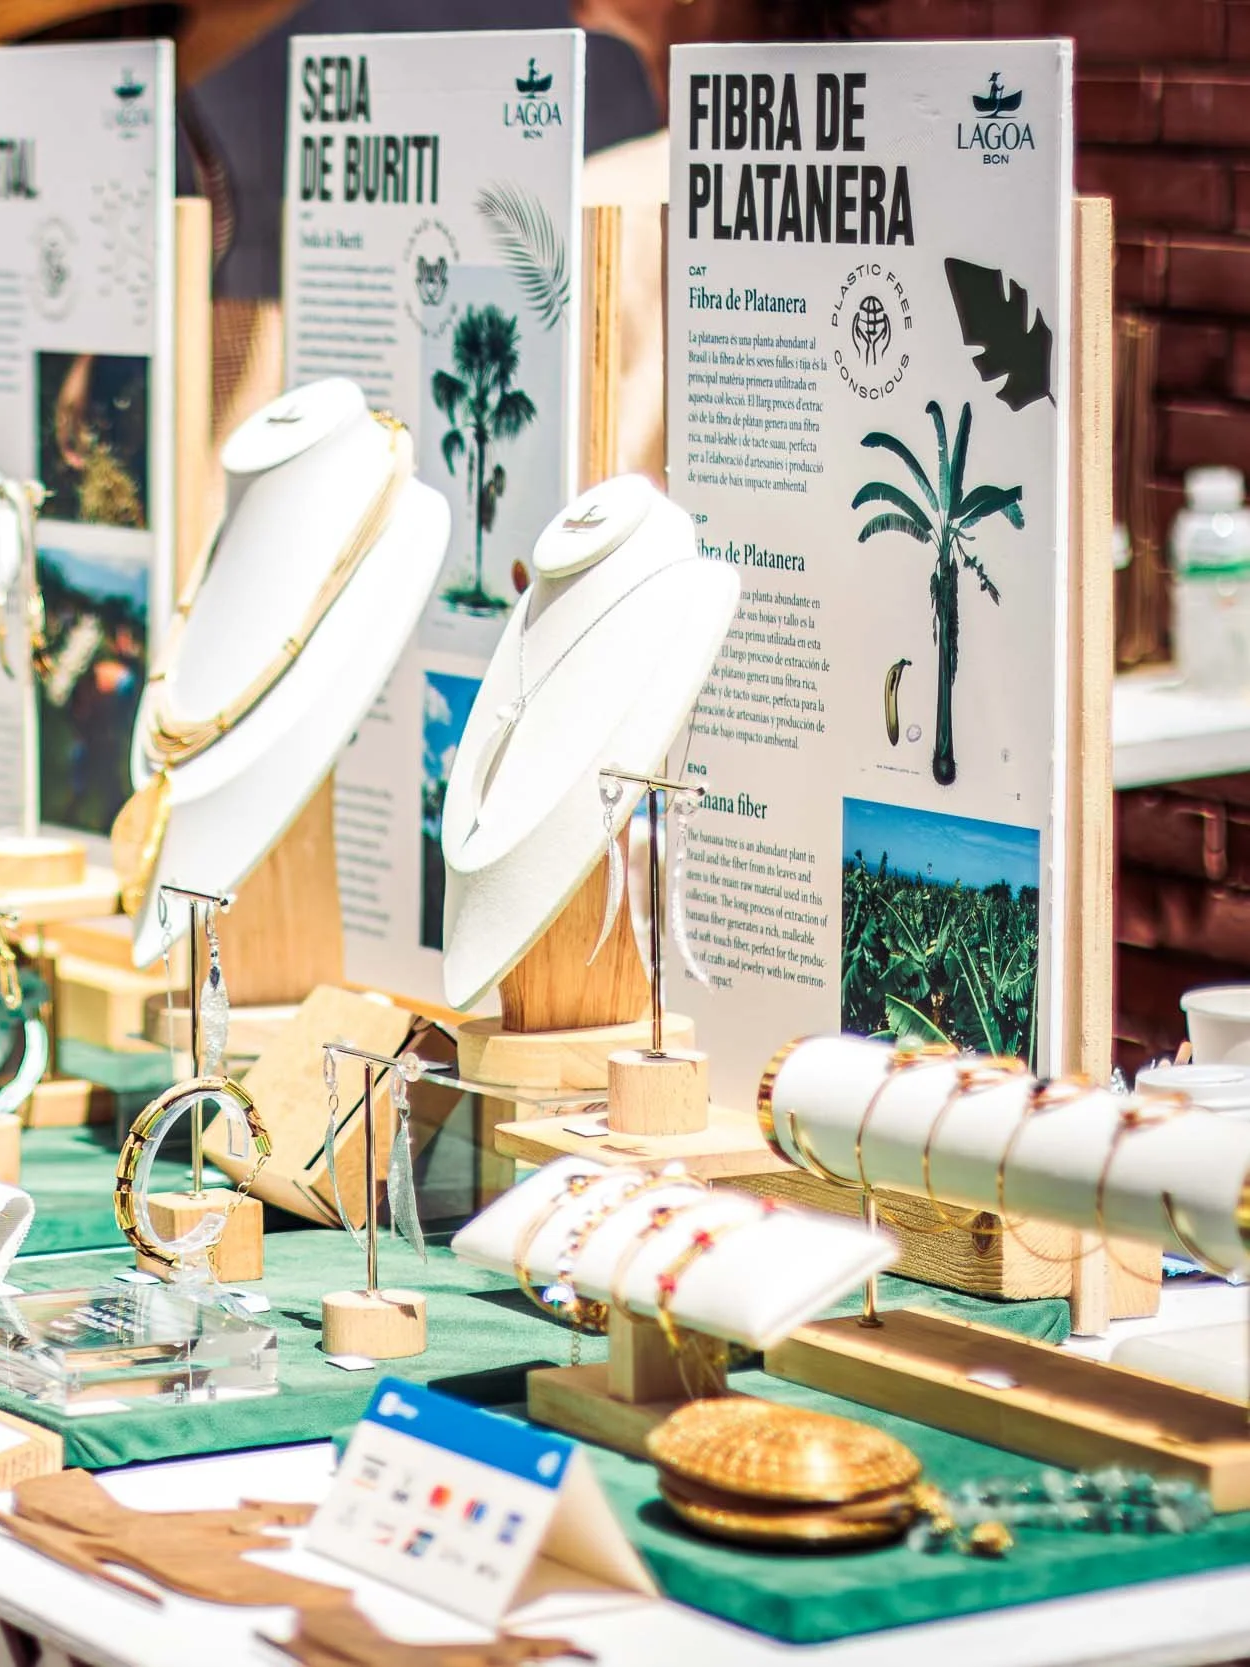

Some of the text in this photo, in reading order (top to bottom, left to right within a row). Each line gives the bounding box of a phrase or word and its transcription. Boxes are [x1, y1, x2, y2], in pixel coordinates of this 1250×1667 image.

[301, 55, 371, 123] SEDA
[504, 102, 562, 127] LAGOA
[689, 72, 866, 151] FIBRA DE
[957, 122, 1036, 150] LAGOA
[300, 135, 334, 202] DE
[344, 135, 440, 204] BURITI
[983, 153, 1009, 165] BCN
[689, 163, 915, 246] PLATANERA
[688, 266, 707, 276] CAT
[688, 285, 807, 314] Fibra de Platanera
[831, 263, 913, 331] PLASTIC FREE
[688, 330, 816, 350] La platanera una planta abundant al
[688, 350, 828, 371] Brasil la fibra de les seves fulles la
[688, 371, 817, 392] principal matèria primera utilitzada en
[834, 349, 910, 401] CONSCIOUS
[688, 393, 713, 407] aquesta
[748, 392, 755, 407] El
[756, 394, 771, 412] llarg
[700, 411, 707, 423] de
[709, 411, 715, 424] la
[716, 411, 731, 425] fibra
[733, 412, 741, 426] de
[764, 418, 787, 432] genera
[789, 419, 802, 431] una
[803, 417, 820, 432] fibra
[742, 433, 817, 454] de tacte perfecta
[688, 452, 699, 465] per
[789, 459, 824, 476] producció
[688, 468, 772, 492] de de baix impacte
[697, 537, 805, 572] ibra de Platanera
[752, 589, 821, 609] planta abundante en
[737, 607, 746, 620] de
[747, 611, 758, 621] sus
[759, 608, 777, 626] hojas
[783, 612, 799, 628] tallo
[800, 619, 808, 629] es
[809, 614, 815, 629] la
[745, 630, 822, 650] prima utilizada en esta
[721, 644, 831, 672] El largo proceso de extracción de
[746, 671, 770, 685] genera
[771, 675, 784, 687] una
[785, 672, 801, 688] fibra
[724, 684, 731, 698] de
[733, 688, 750, 701] tacto
[773, 693, 800, 709] perfecta
[801, 699, 817, 713] para
[818, 697, 825, 713] la
[711, 722, 763, 744] de bajo impacto
[727, 706, 735, 719] de
[776, 714, 815, 731] producción
[816, 719, 826, 733] de
[687, 762, 707, 776] ENG
[697, 792, 768, 820] nana fiber
[687, 828, 815, 865] The banana tree is an abundant plant in
[687, 847, 811, 883] Brazil and the fiber from its leaves and
[710, 871, 720, 885] the
[722, 876, 739, 888] main
[740, 881, 752, 892] raw
[754, 883, 782, 898] material
[783, 888, 800, 902] used
[801, 889, 808, 904] in
[809, 890, 823, 906] this
[721, 893, 829, 928] The long process of extraction of
[685, 906, 710, 923] banana
[710, 911, 726, 925] fiber
[727, 919, 759, 933] generates
[782, 927, 815, 945] malleable
[713, 934, 732, 948] touch
[751, 942, 775, 957] perfect
[776, 945, 787, 959] for
[787, 947, 799, 962] the
[708, 952, 726, 966] crafts
[727, 955, 740, 969] and
[740, 959, 765, 979] jewelry
[766, 964, 782, 979] with
[783, 966, 796, 983] low
